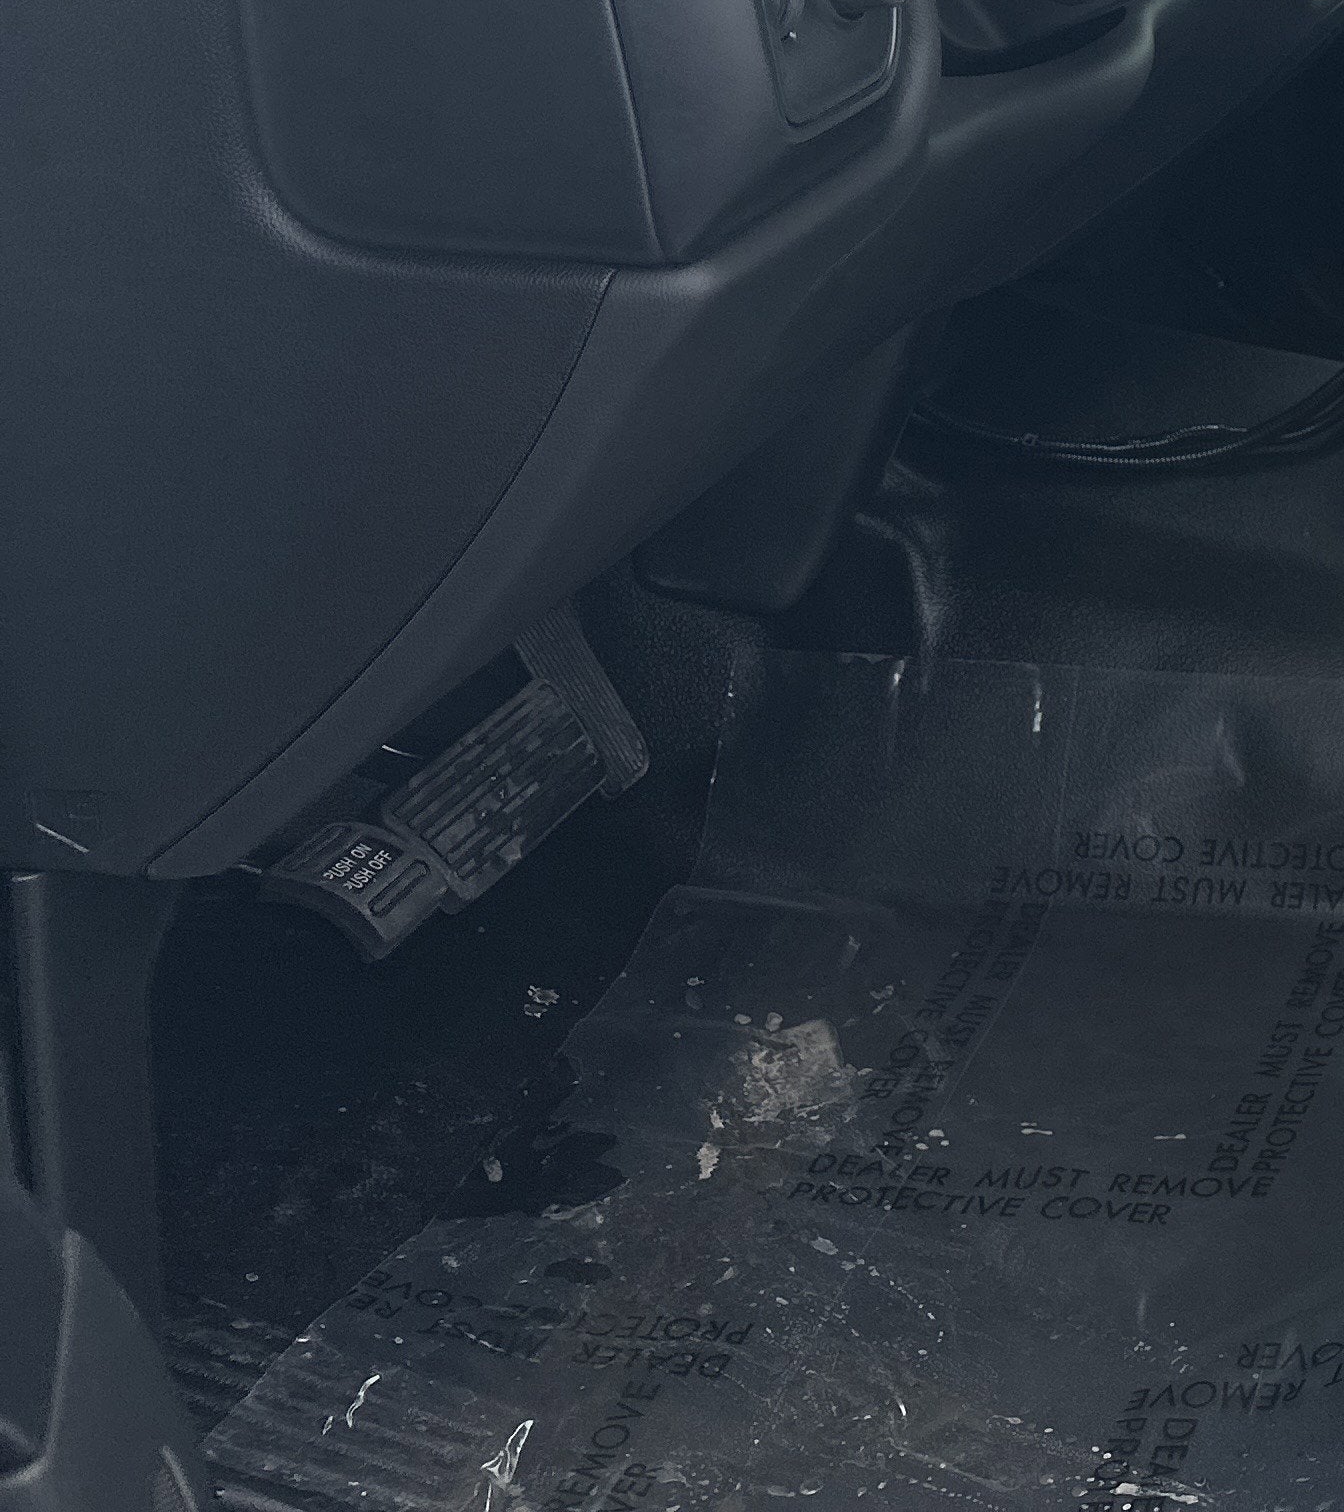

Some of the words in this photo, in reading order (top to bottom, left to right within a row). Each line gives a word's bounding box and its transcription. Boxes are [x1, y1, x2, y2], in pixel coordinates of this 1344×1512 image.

[351, 843, 372, 859] ON
[368, 850, 392, 869] OFF
[1072, 830, 1184, 864] COVER
[988, 864, 1132, 902] REMOVE
[1150, 875, 1244, 907] MUST
[1209, 1093, 1271, 1174] DEALER
[1255, 1022, 1303, 1079] MUST
[1252, 1045, 1334, 1175] PROTECTIVE
[806, 1153, 952, 1187] DEALER
[976, 1165, 1090, 1193] MUST
[1108, 1172, 1276, 1200] REMOVE
[790, 1180, 1026, 1218] PROTECTIVE
[1040, 1196, 1173, 1226] COVER
[1124, 1376, 1305, 1414] REMOVE
